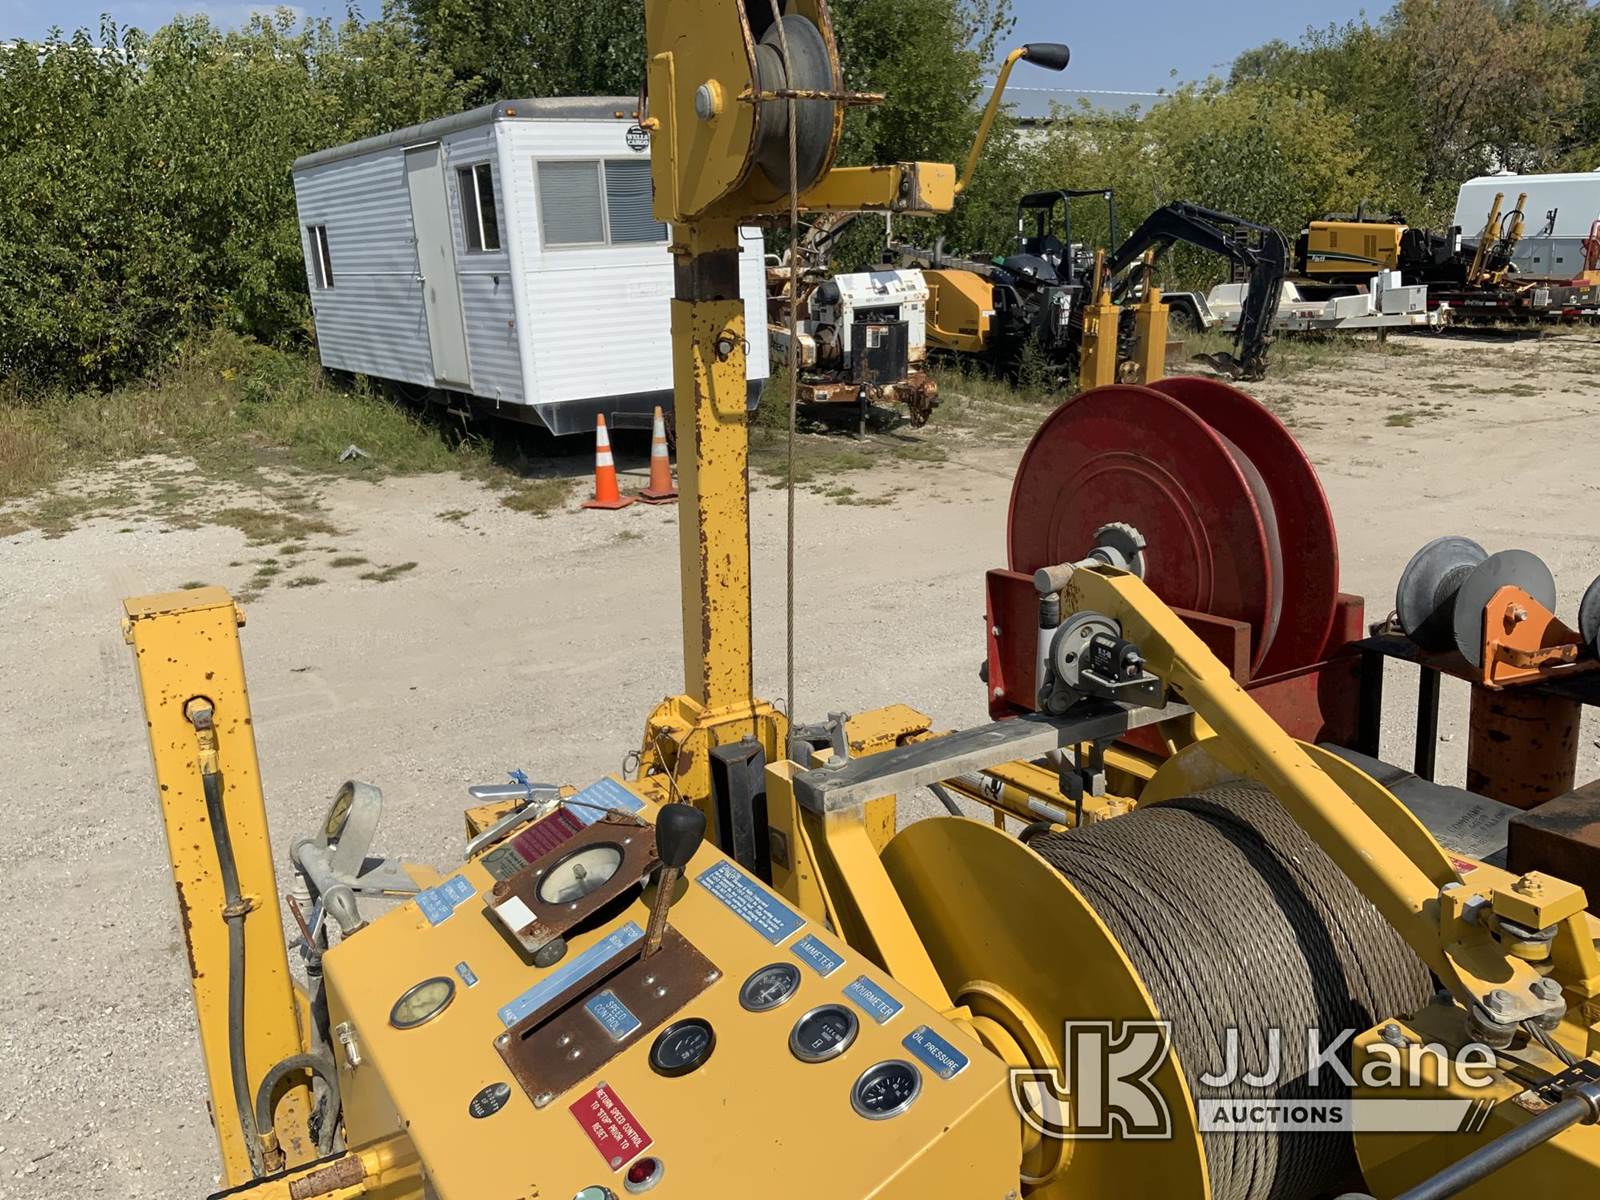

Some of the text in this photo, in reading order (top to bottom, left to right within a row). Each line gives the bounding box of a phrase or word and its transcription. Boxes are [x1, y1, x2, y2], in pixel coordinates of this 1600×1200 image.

[800, 941, 835, 970] AMMETER
[605, 1000, 627, 1021] SPEED
[851, 981, 894, 1017] HOURMETER
[594, 1004, 621, 1032] CONTROL
[911, 1032, 959, 1071] OIL PRESSURE
[590, 1099, 600, 1111] TO
[607, 1122, 623, 1141] PRIOR
[620, 1139, 630, 1151] TO
[591, 1123, 609, 1141] RESET
[596, 1089, 643, 1149] RETURN SPEED CONTROL
